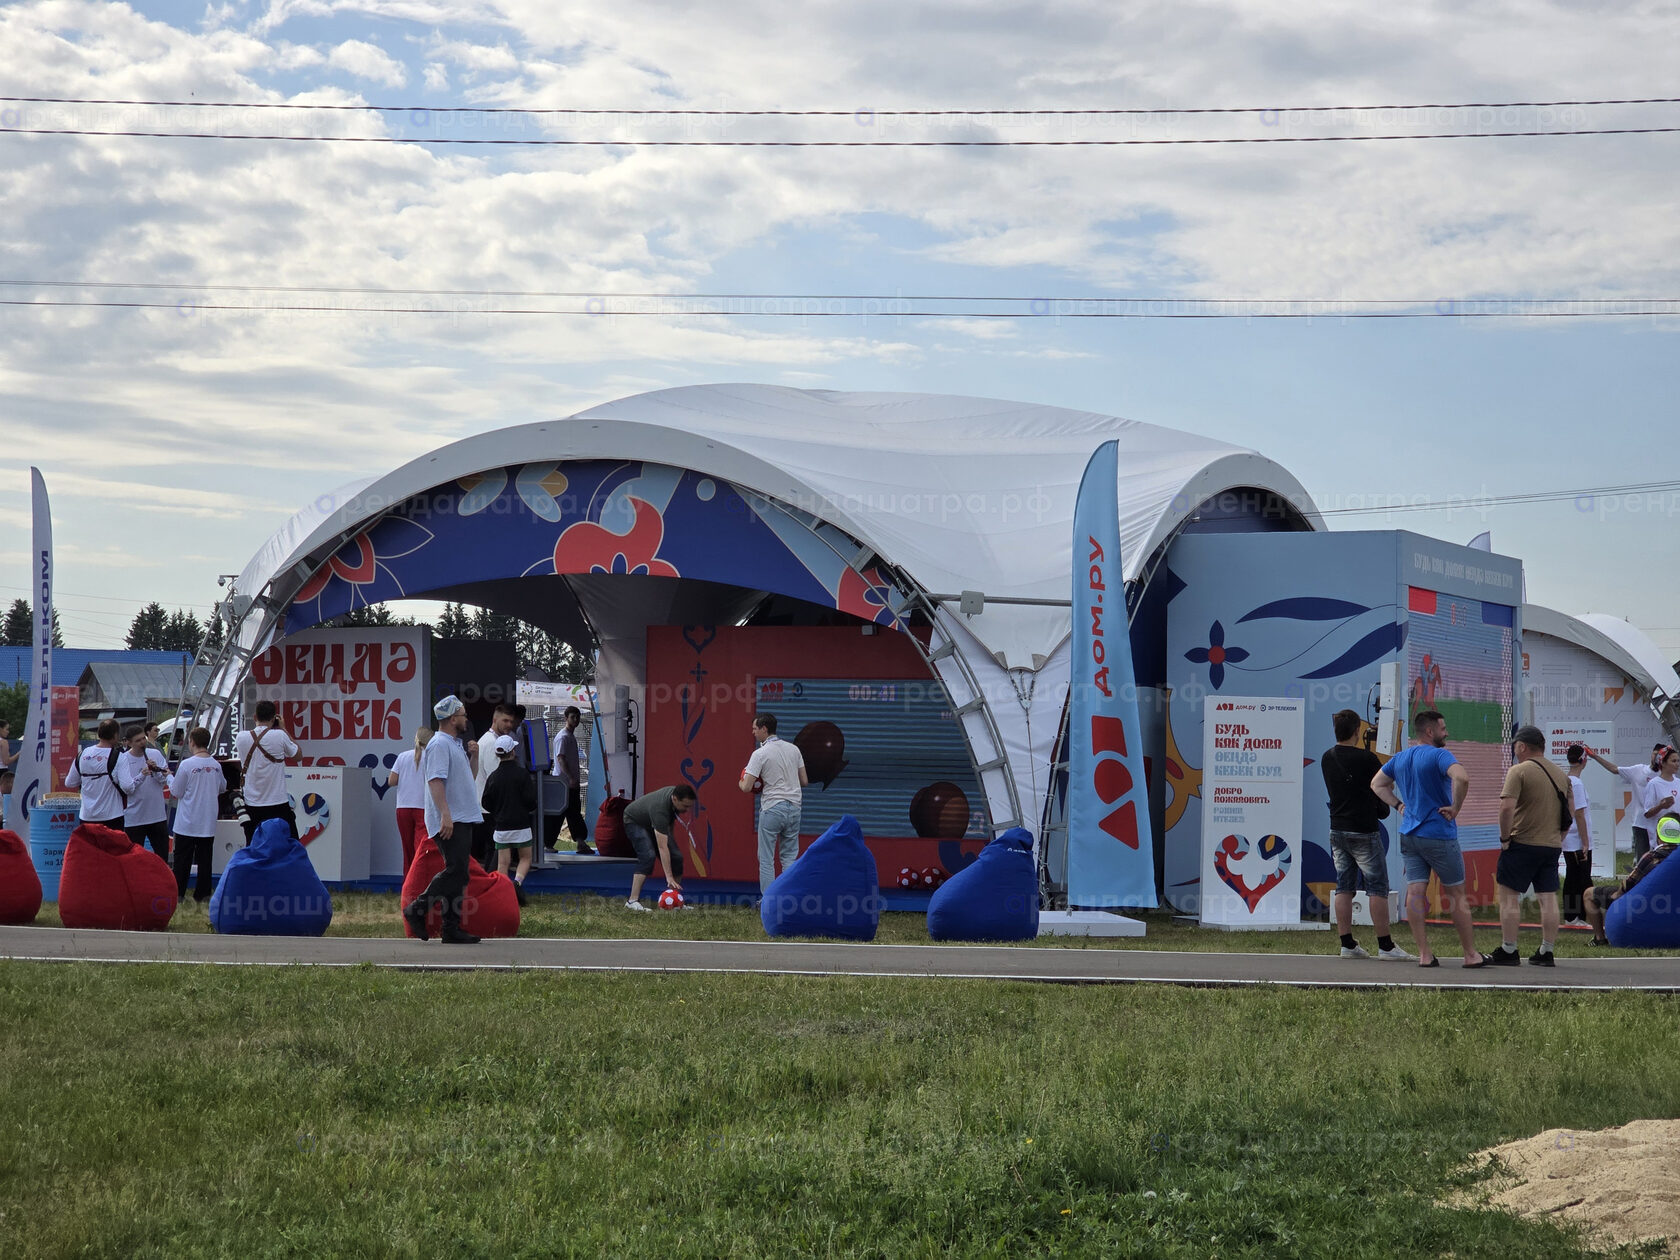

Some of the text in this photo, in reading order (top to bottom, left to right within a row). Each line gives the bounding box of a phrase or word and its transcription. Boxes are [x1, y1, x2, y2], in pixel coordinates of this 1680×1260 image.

[1089, 535, 1112, 697] дом.ру
[275, 698, 403, 740] ЕБЕК
[1215, 724, 1249, 737] БУДЬ
[1215, 737, 1282, 751] КАК ДОМА
[1214, 787, 1242, 796] ДОБРО
[1214, 796, 1270, 804] ПОЖАЛОВАТЬ
